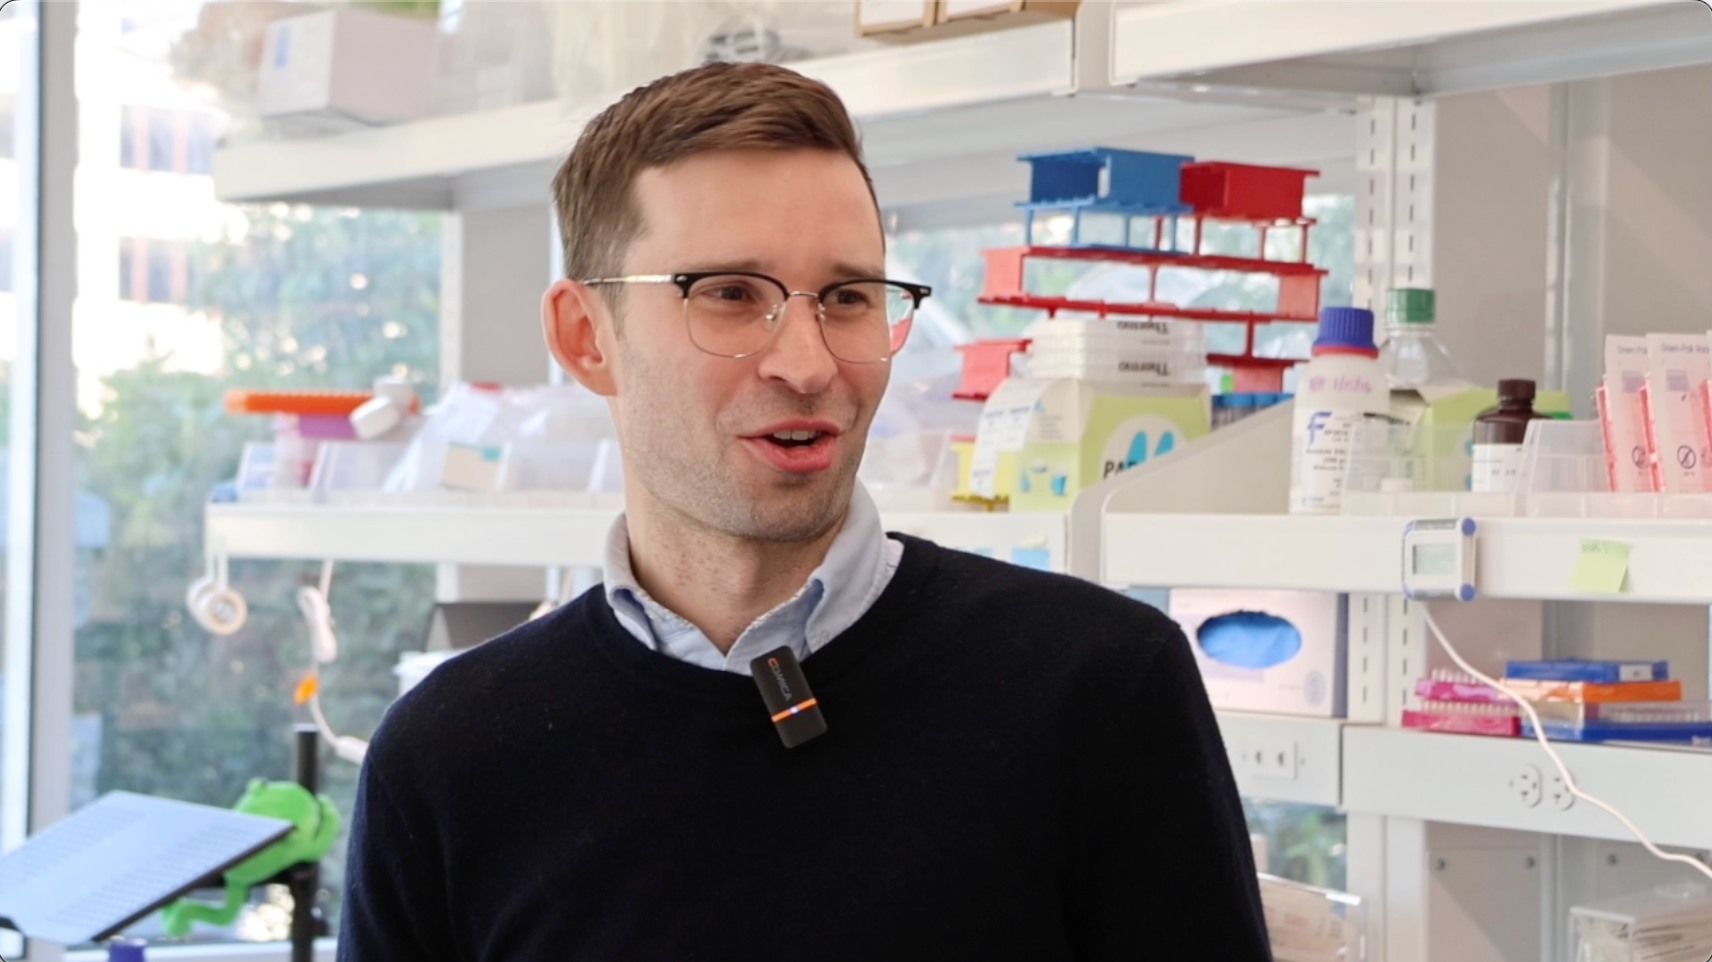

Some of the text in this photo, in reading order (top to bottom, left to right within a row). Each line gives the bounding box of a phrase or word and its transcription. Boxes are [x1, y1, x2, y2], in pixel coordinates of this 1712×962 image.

[1117, 320, 1170, 335] Thermo
[1118, 361, 1170, 377] Thermo
[1102, 460, 1139, 479] PA
[768, 657, 792, 702] COMICA
